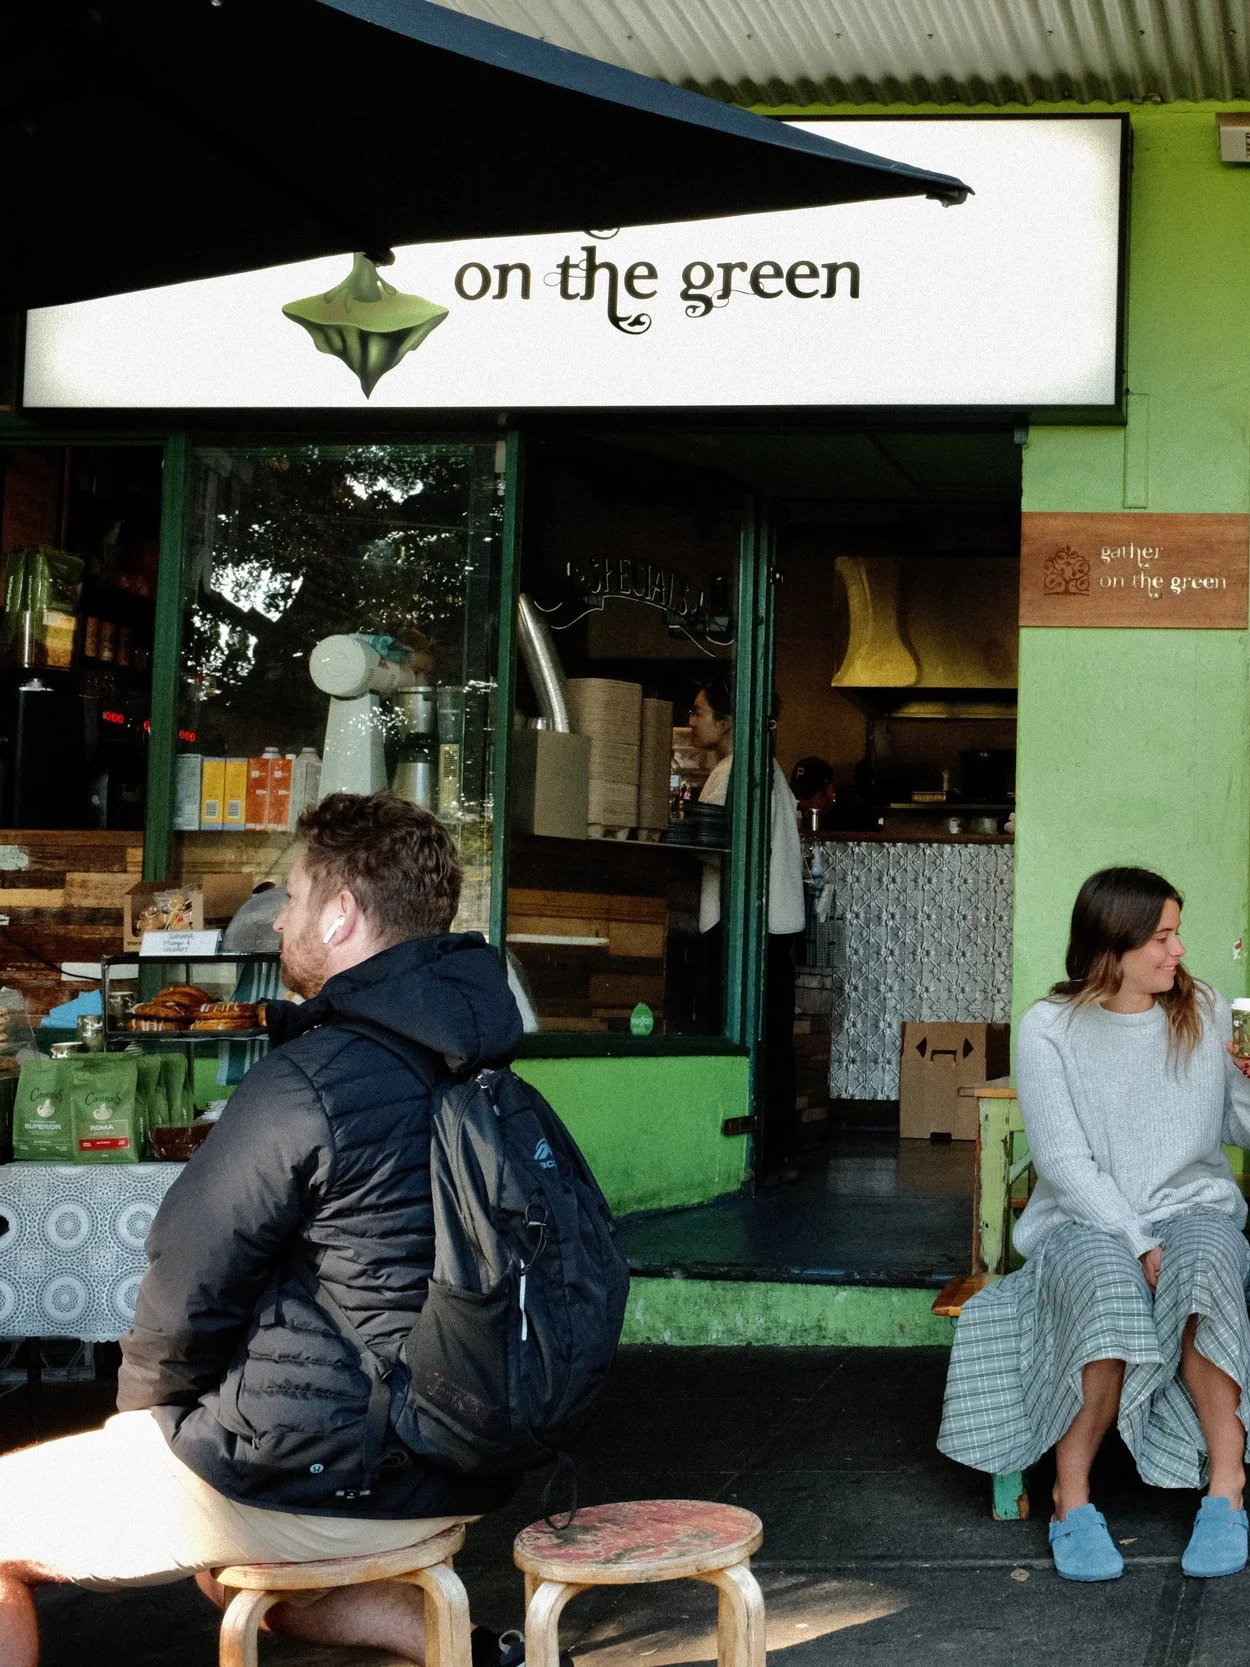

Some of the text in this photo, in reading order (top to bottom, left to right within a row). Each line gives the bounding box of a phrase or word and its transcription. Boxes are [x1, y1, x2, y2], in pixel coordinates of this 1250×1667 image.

[454, 245, 860, 335] on the green
[1100, 542, 1164, 568] gather
[1100, 571, 1226, 599] on the green
[90, 1124, 115, 1132] ROMA
